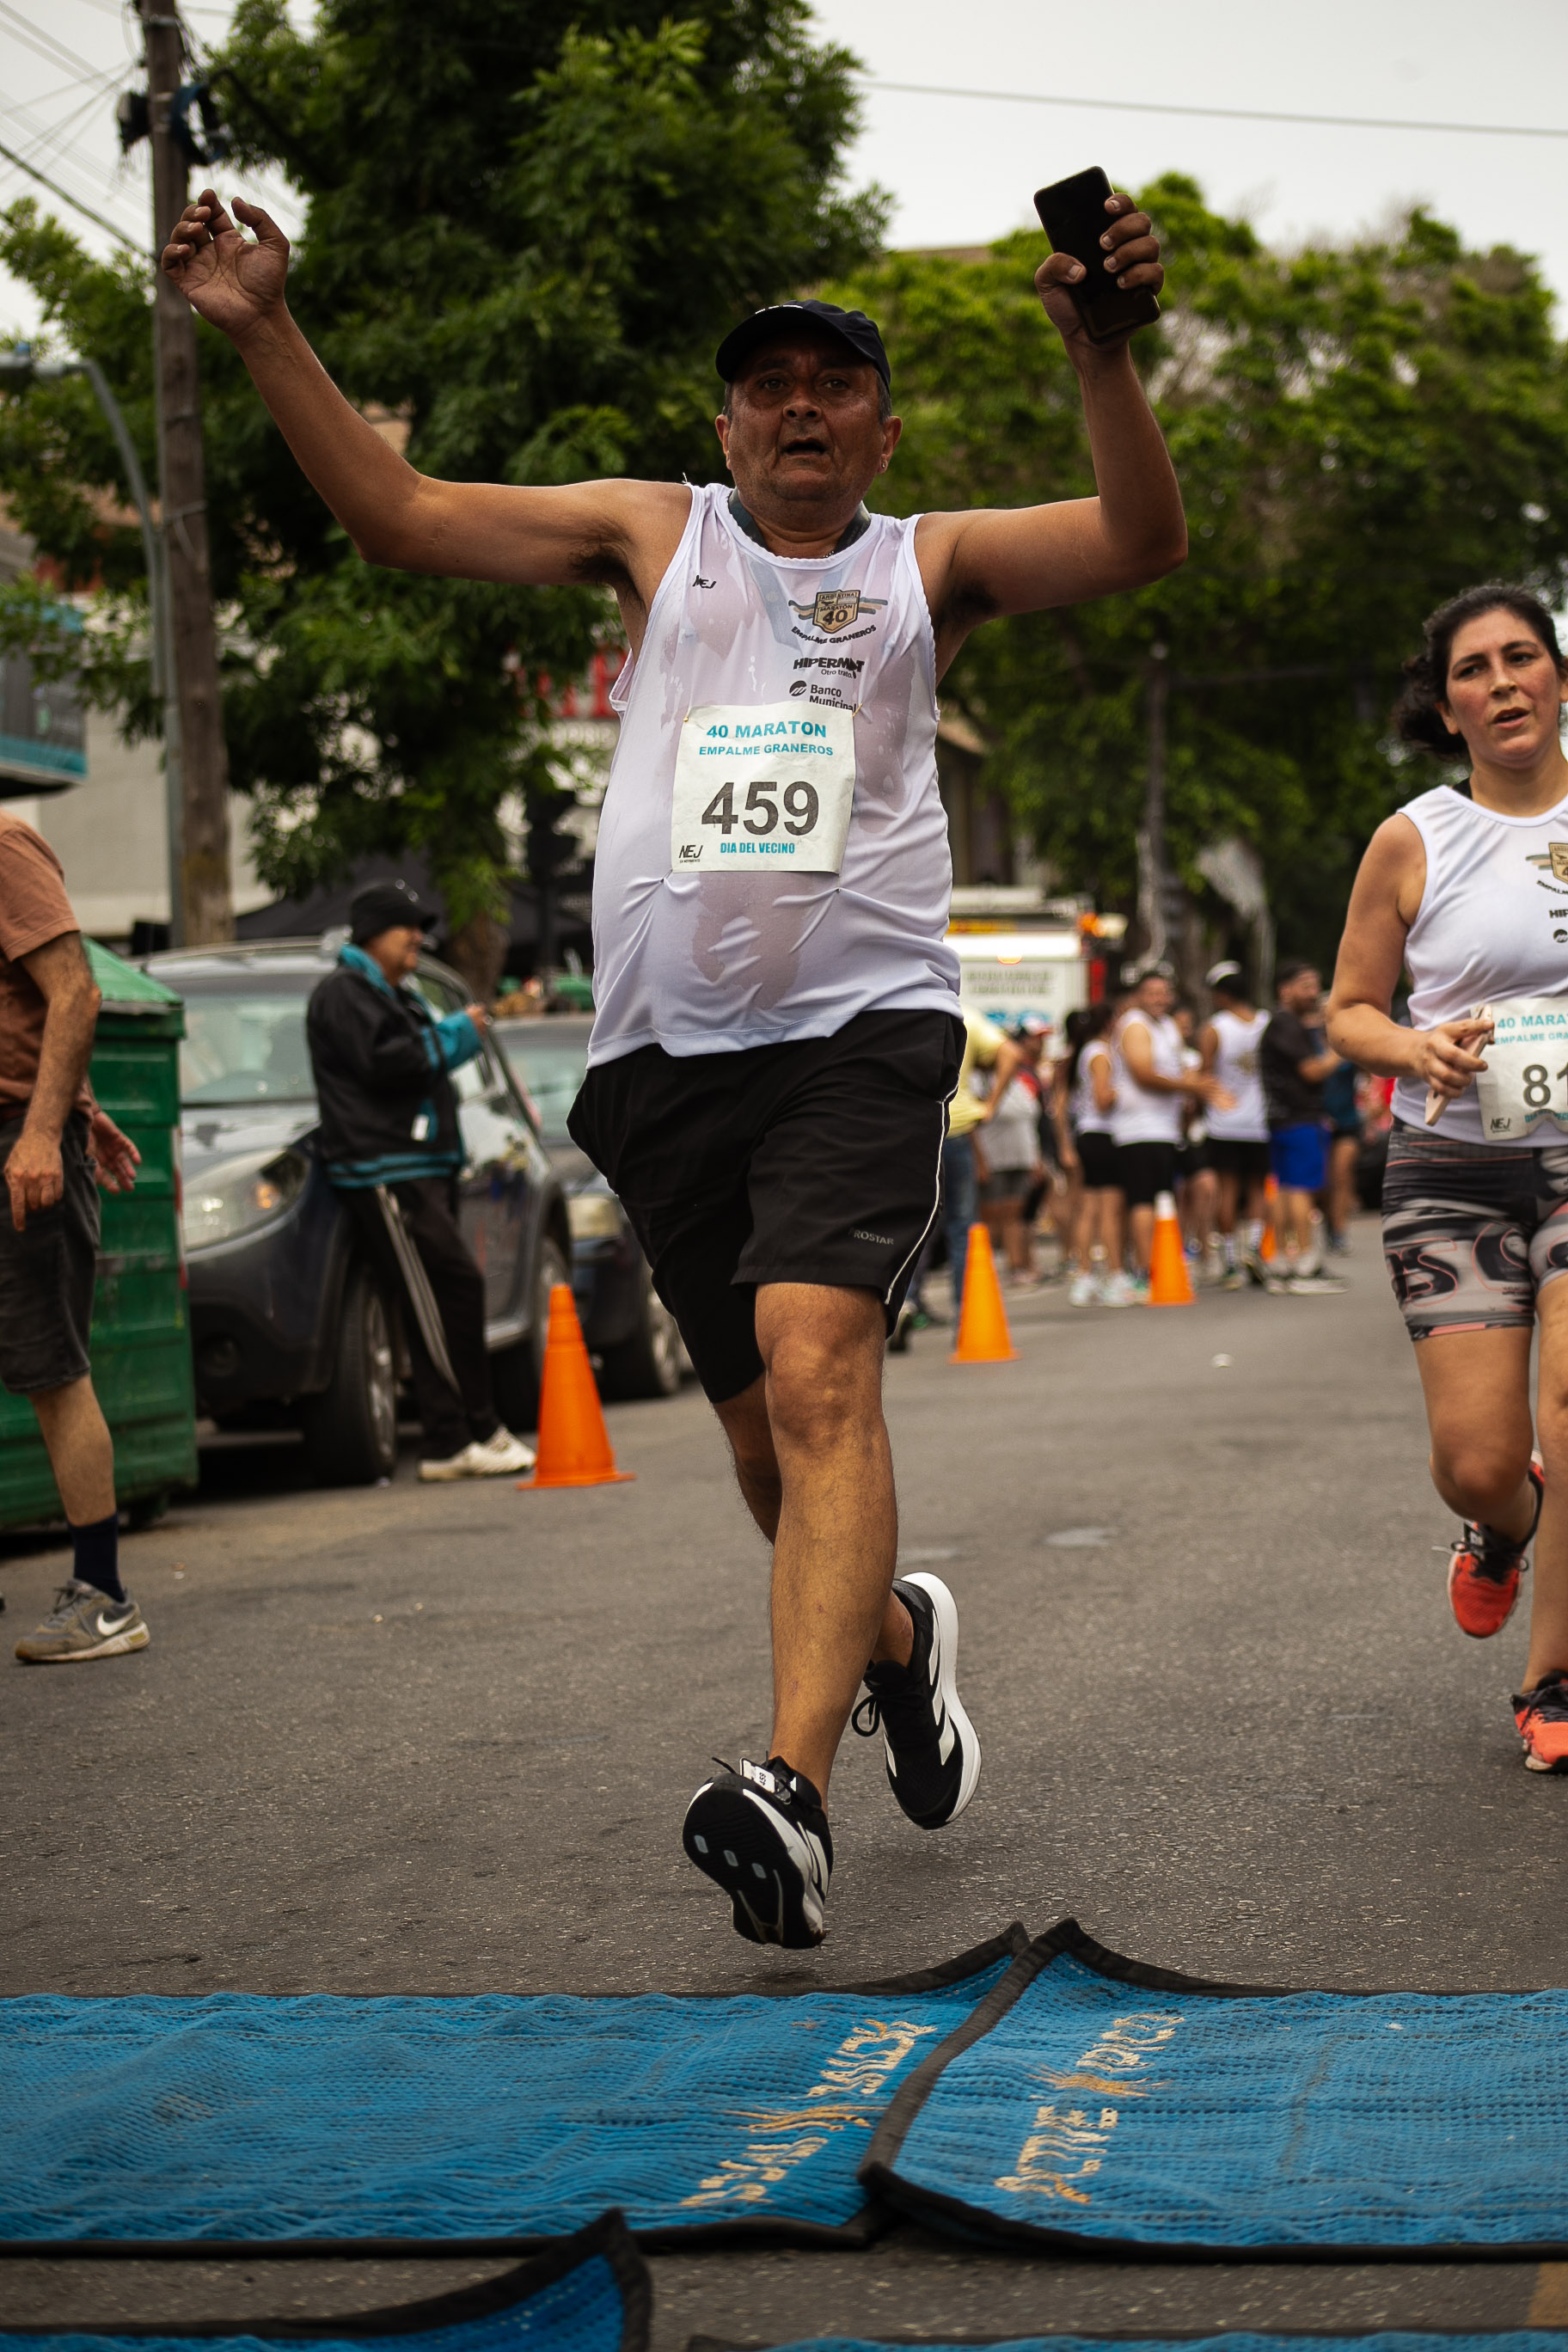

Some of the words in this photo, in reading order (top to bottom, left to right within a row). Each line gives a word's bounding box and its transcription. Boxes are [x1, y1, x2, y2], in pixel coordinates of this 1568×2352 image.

[823, 609, 848, 625] 40
[791, 626, 828, 644] EMPALME
[829, 624, 877, 644] GRANEROS
[810, 684, 842, 697] Banco
[707, 725, 729, 738] 40
[735, 720, 826, 738] MARATON
[699, 745, 761, 756] EMPALME
[763, 744, 834, 756] GRANEROS
[701, 781, 819, 836] 459
[678, 844, 703, 859] NEJ
[720, 842, 738, 854] DIA
[739, 842, 756, 854] DEL
[759, 842, 795, 854] VECINO
[1497, 1017, 1516, 1029] 40
[1521, 1014, 1568, 1028] MARA
[1494, 1033, 1546, 1045] EMPALME
